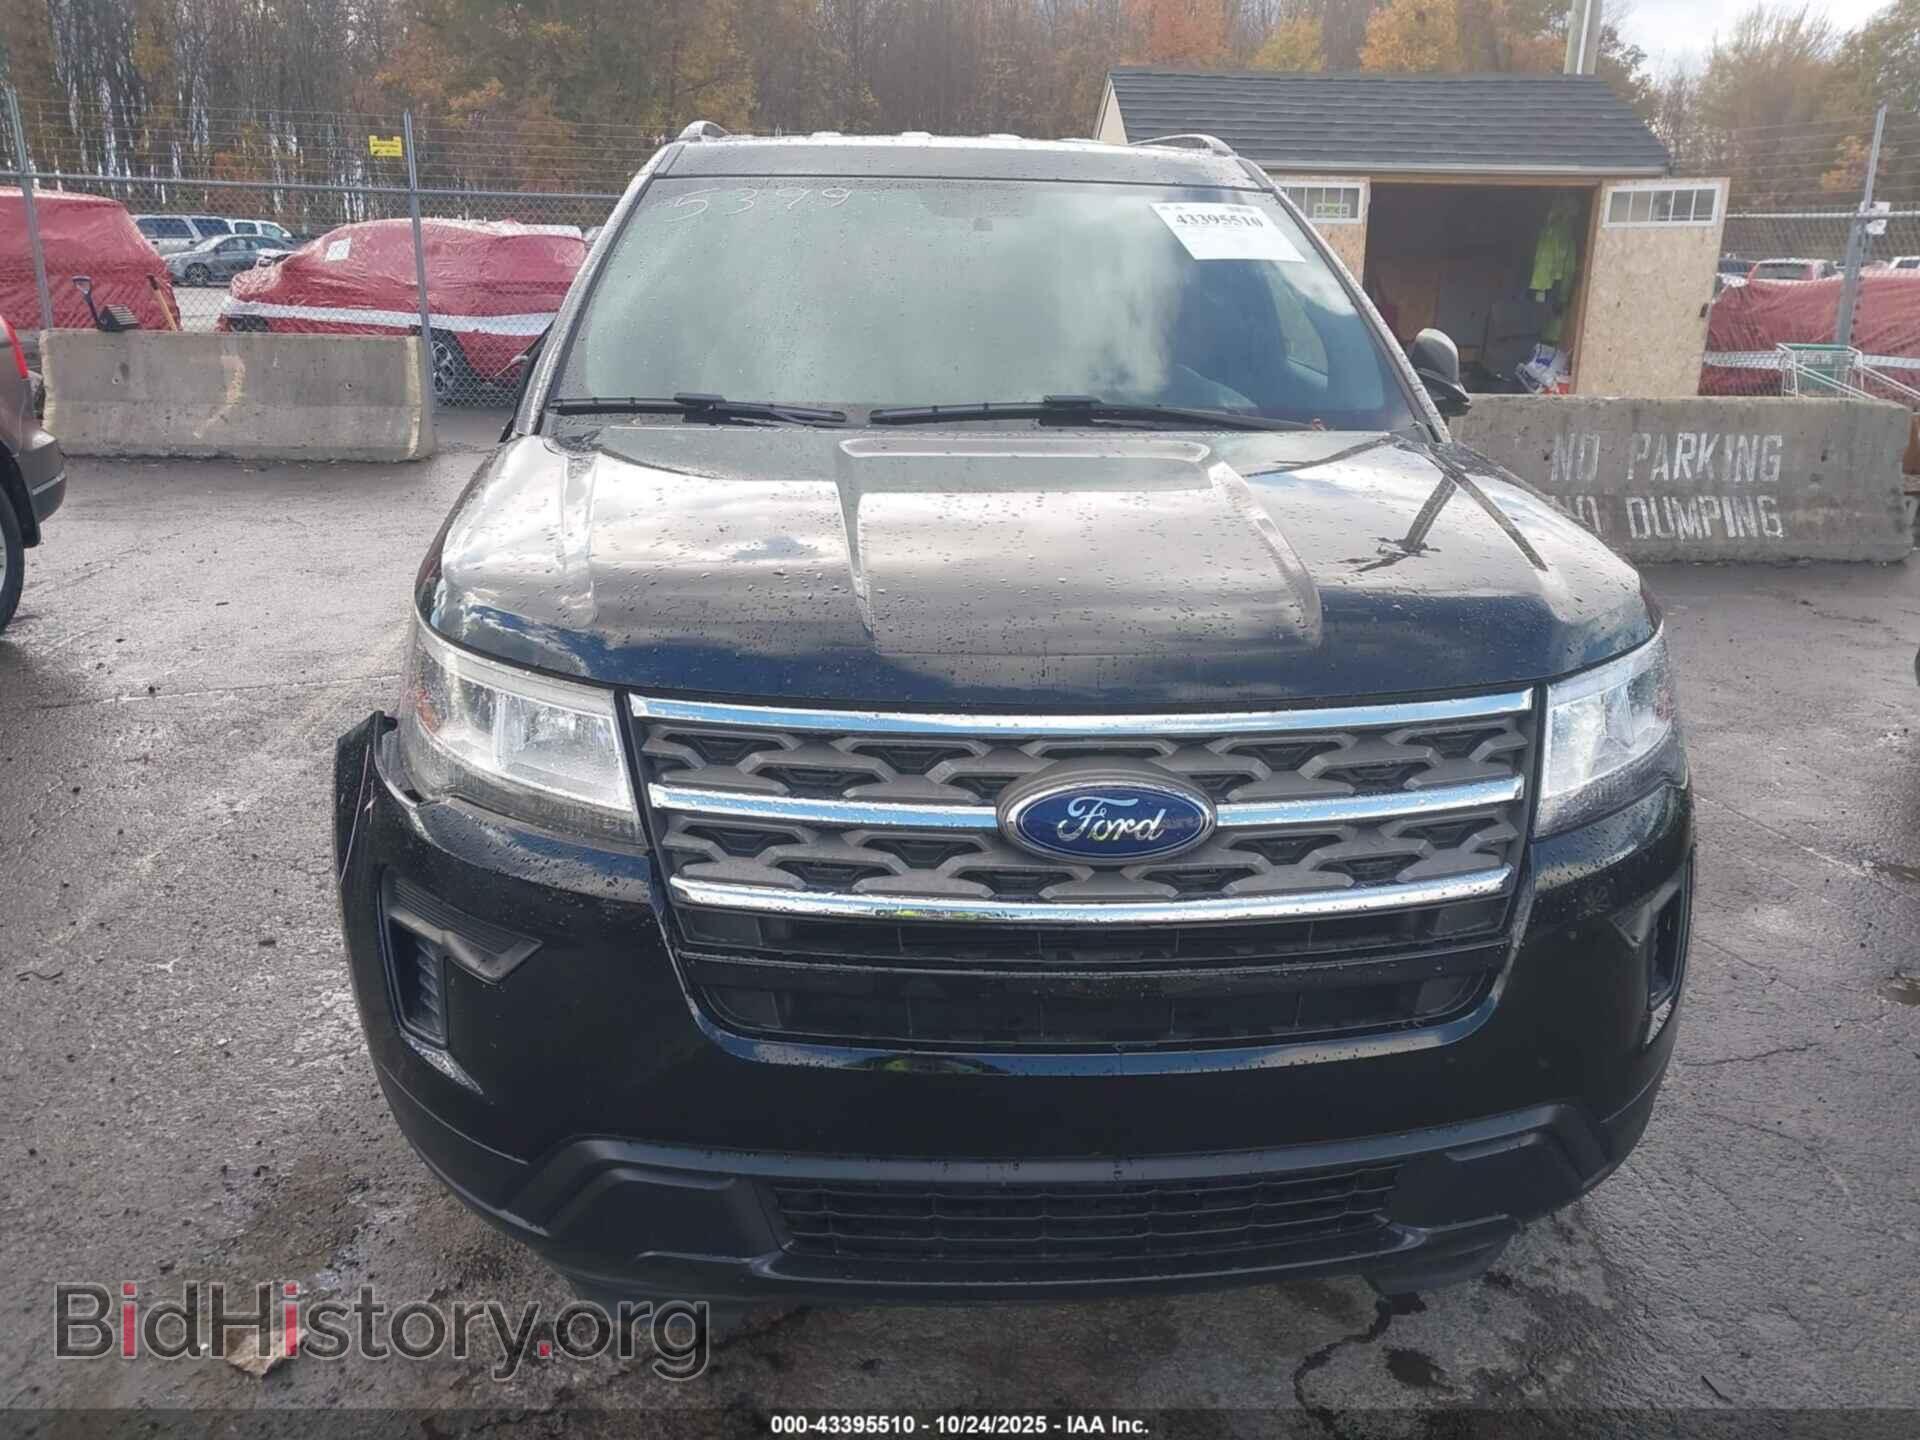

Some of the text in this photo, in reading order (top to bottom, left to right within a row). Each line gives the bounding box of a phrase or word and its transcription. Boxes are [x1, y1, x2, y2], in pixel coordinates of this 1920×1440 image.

[1551, 432, 1782, 481] NO PARKING
[1627, 495, 1783, 540] DUMPING
[1057, 796, 1166, 841] Ford
